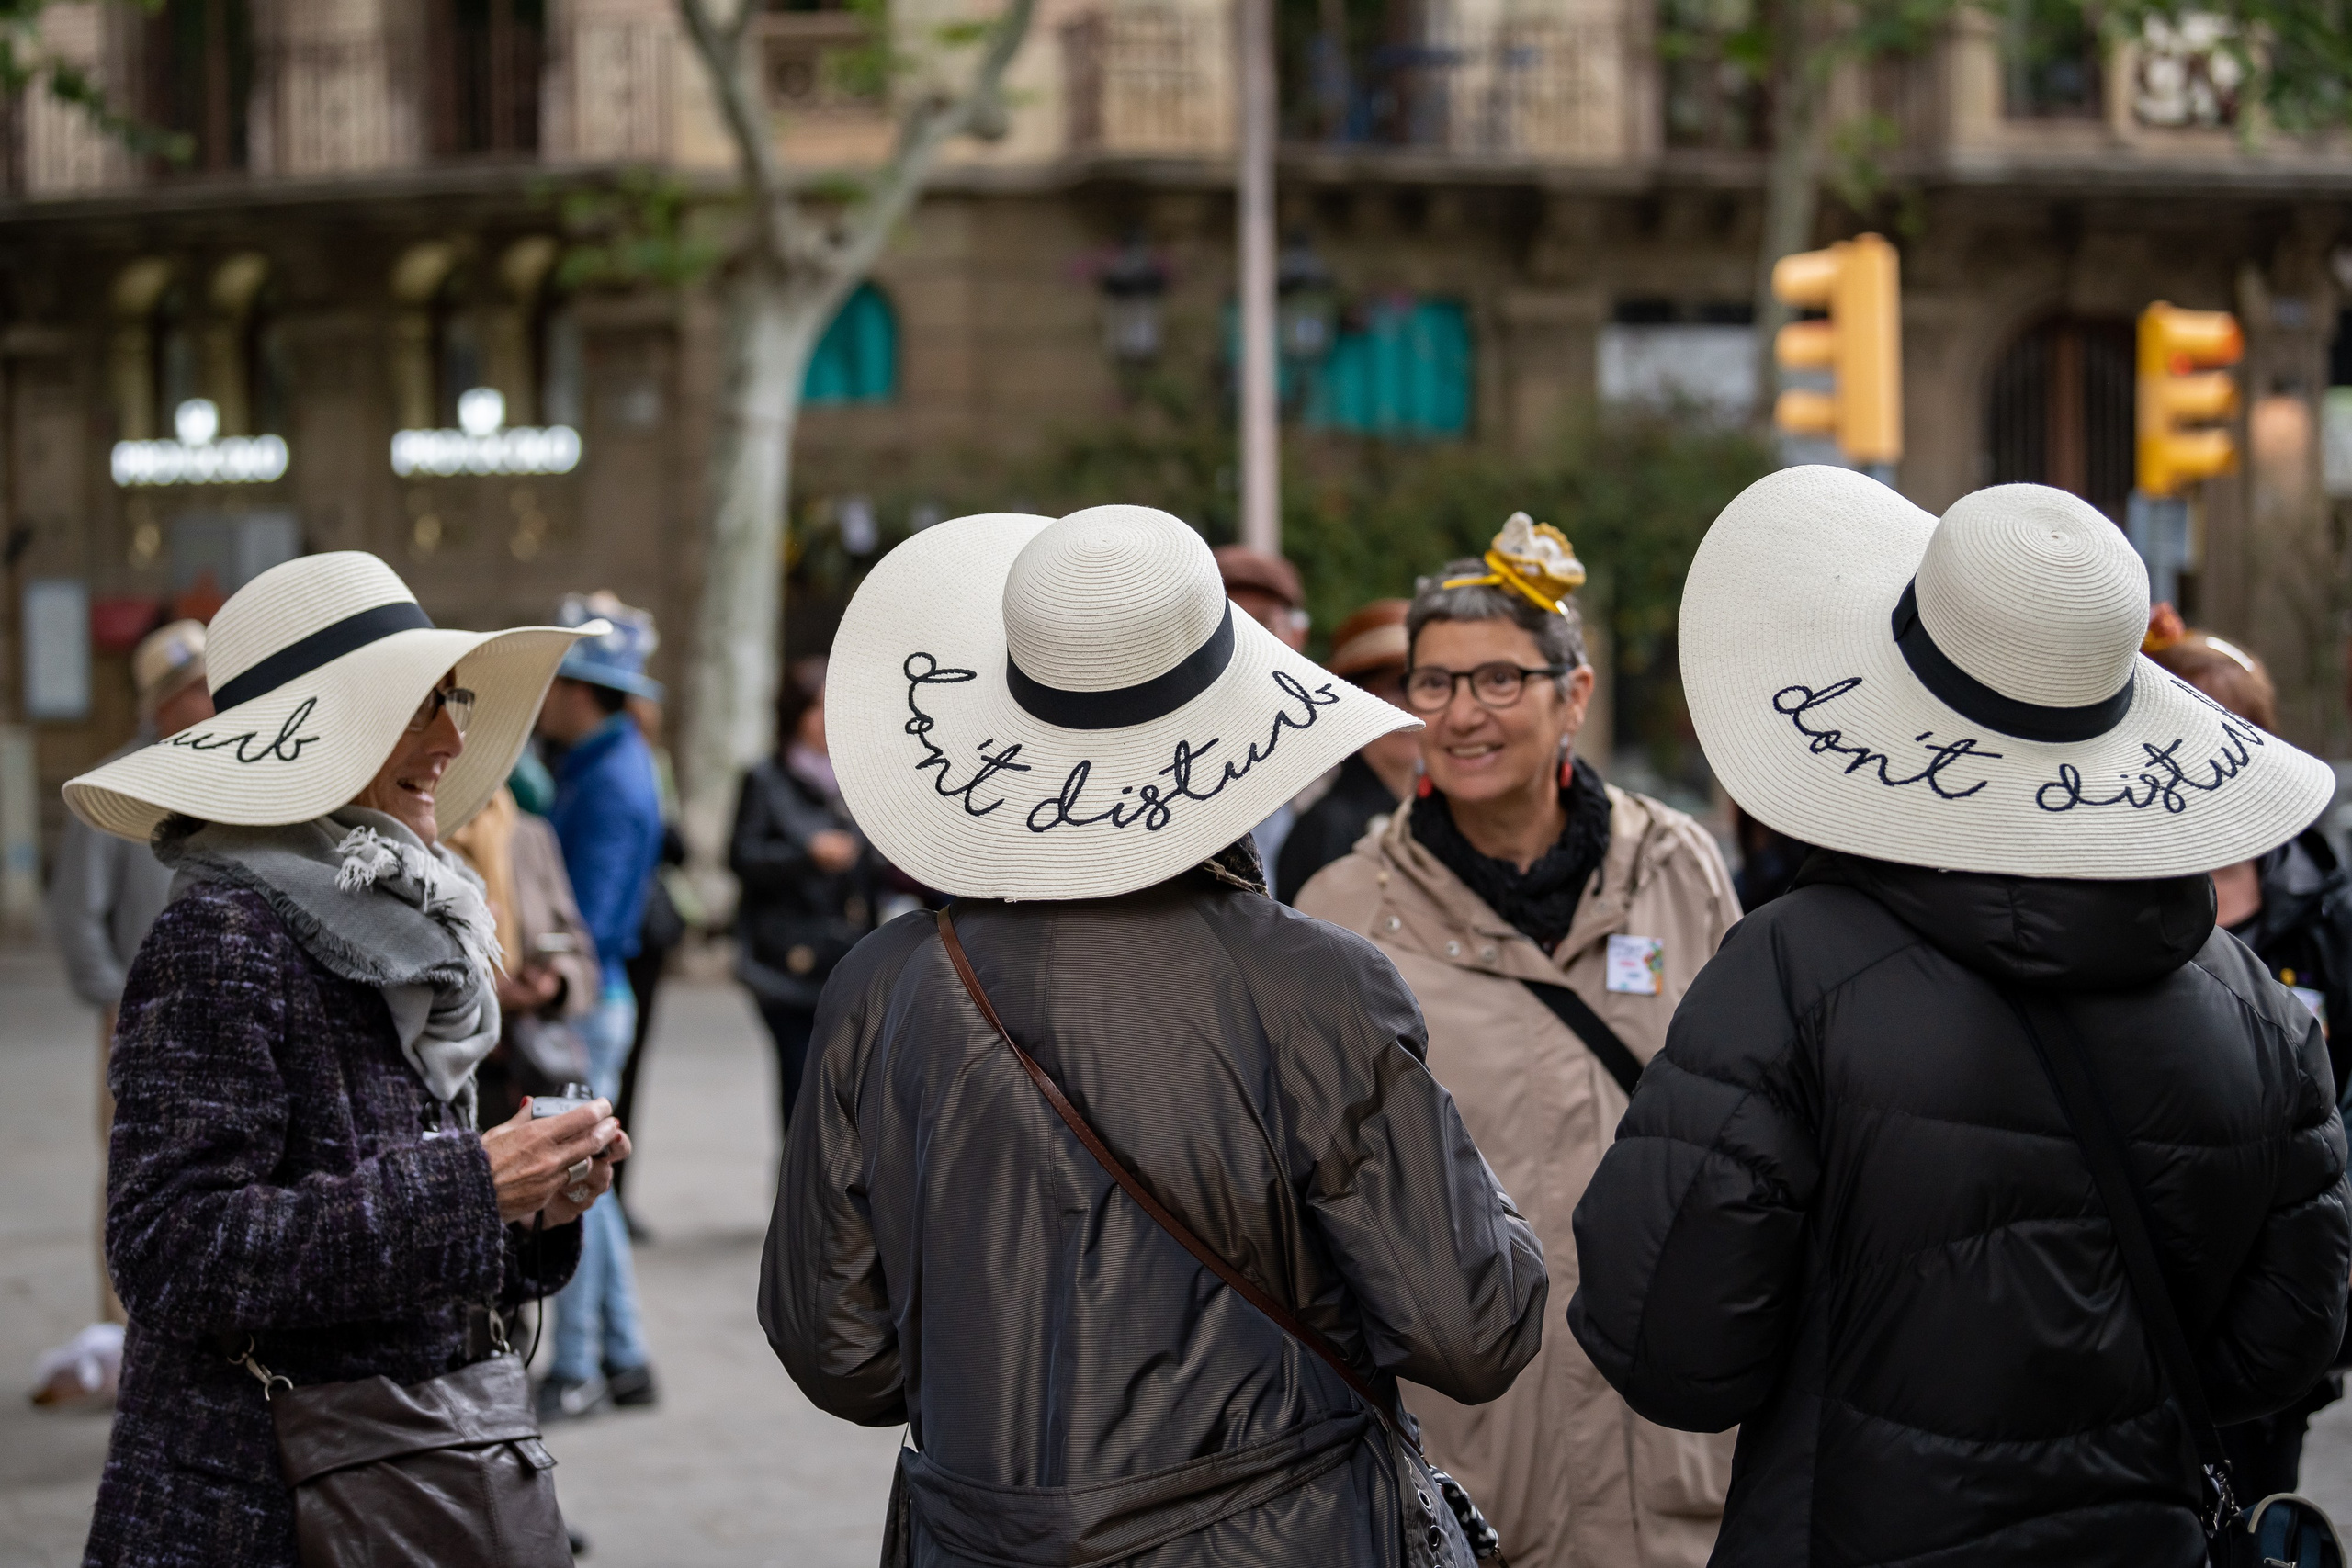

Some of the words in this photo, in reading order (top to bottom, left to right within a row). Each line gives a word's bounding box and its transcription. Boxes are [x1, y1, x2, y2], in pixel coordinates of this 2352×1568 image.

[158, 695, 321, 763] urb
[903, 651, 1032, 818] don't
[1025, 669, 1341, 834] disturb
[1772, 676, 2004, 800] don't
